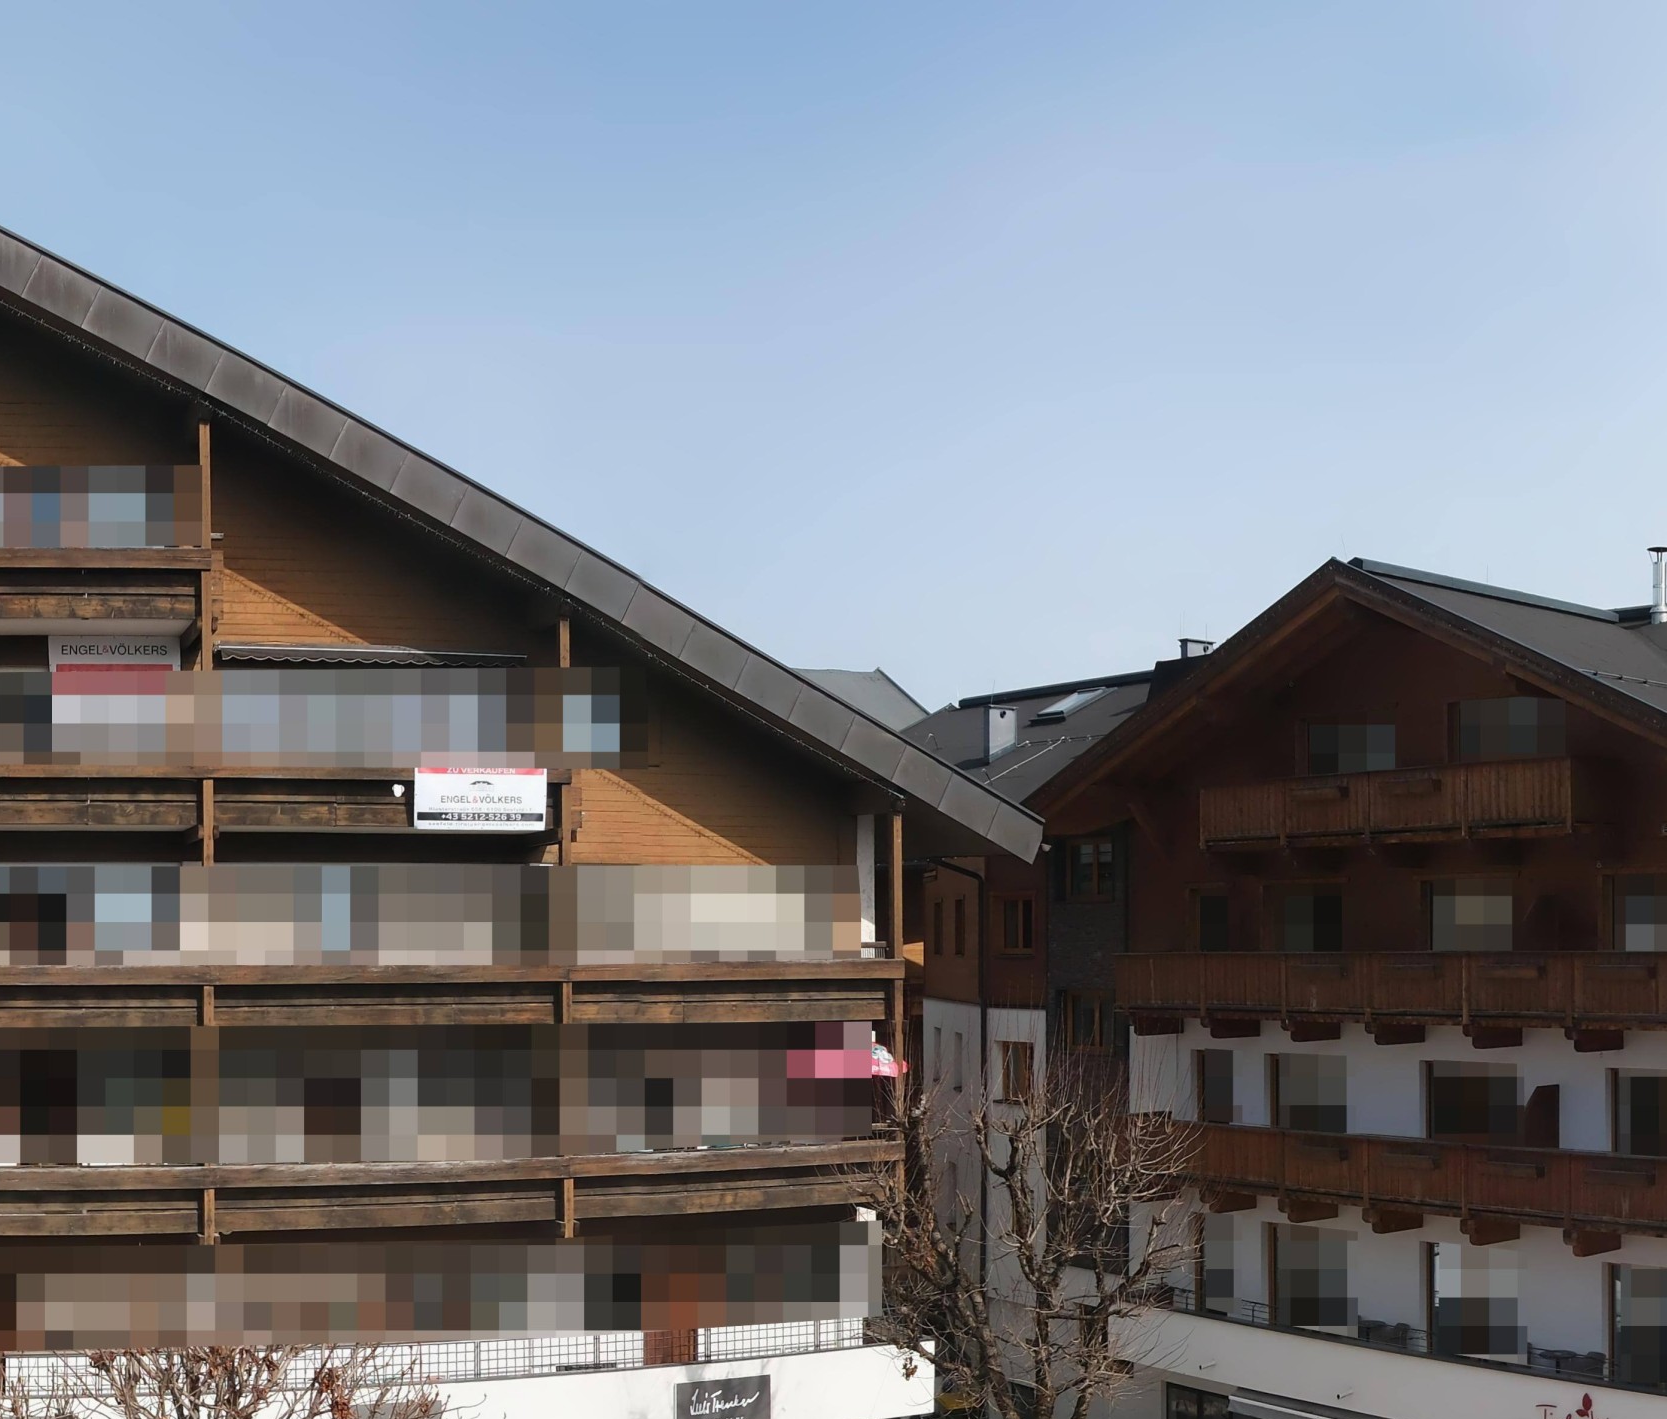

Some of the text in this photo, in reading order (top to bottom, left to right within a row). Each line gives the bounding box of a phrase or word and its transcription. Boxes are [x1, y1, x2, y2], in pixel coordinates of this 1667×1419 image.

[60, 642, 168, 656] ENGEL&VÖLKERS
[440, 794, 523, 805] ENGEL&VÖLKERS
[441, 813, 522, 821] +43 5212-526 39
